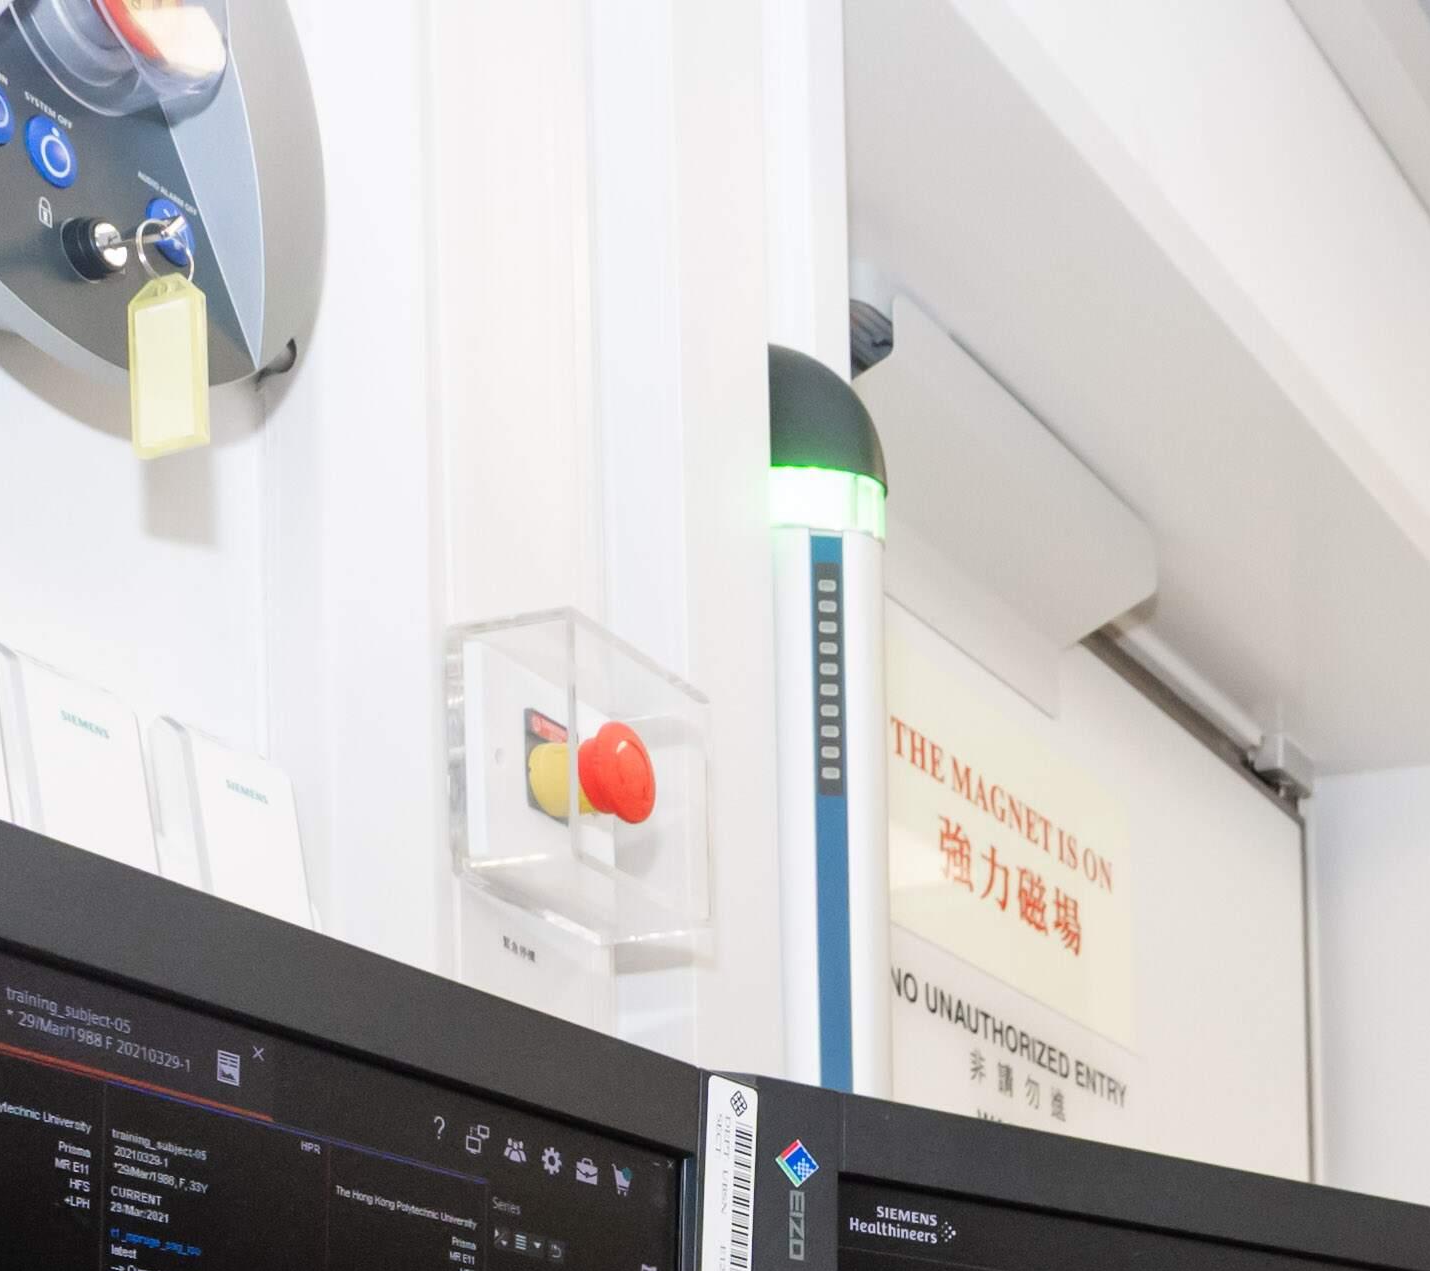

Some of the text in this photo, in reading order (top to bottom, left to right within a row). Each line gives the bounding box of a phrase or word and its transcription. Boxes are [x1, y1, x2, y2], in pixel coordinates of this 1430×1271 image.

[24, 91, 72, 128] SYSTEM OFF
[61, 710, 109, 739] SIEMENS
[226, 779, 268, 804] SIEMENS
[890, 717, 1112, 892] THE MAGNET IS ON
[939, 816, 1082, 956] 強力磁場
[7, 987, 131, 1035] training_subject-05
[18, 1011, 191, 1072] 29/Mar/1988 F 20210329-1
[925, 986, 1070, 1079] UNAUTHORIZED
[1076, 1060, 1127, 1107] ENTRY
[42, 1108, 92, 1134] University
[55, 1157, 90, 1174] MR E11
[70, 1178, 90, 1192] HFS
[789, 1190, 805, 1261] EIZO
[849, 1217, 938, 1244] Healthineers
[876, 1206, 938, 1226] SIEMENS
